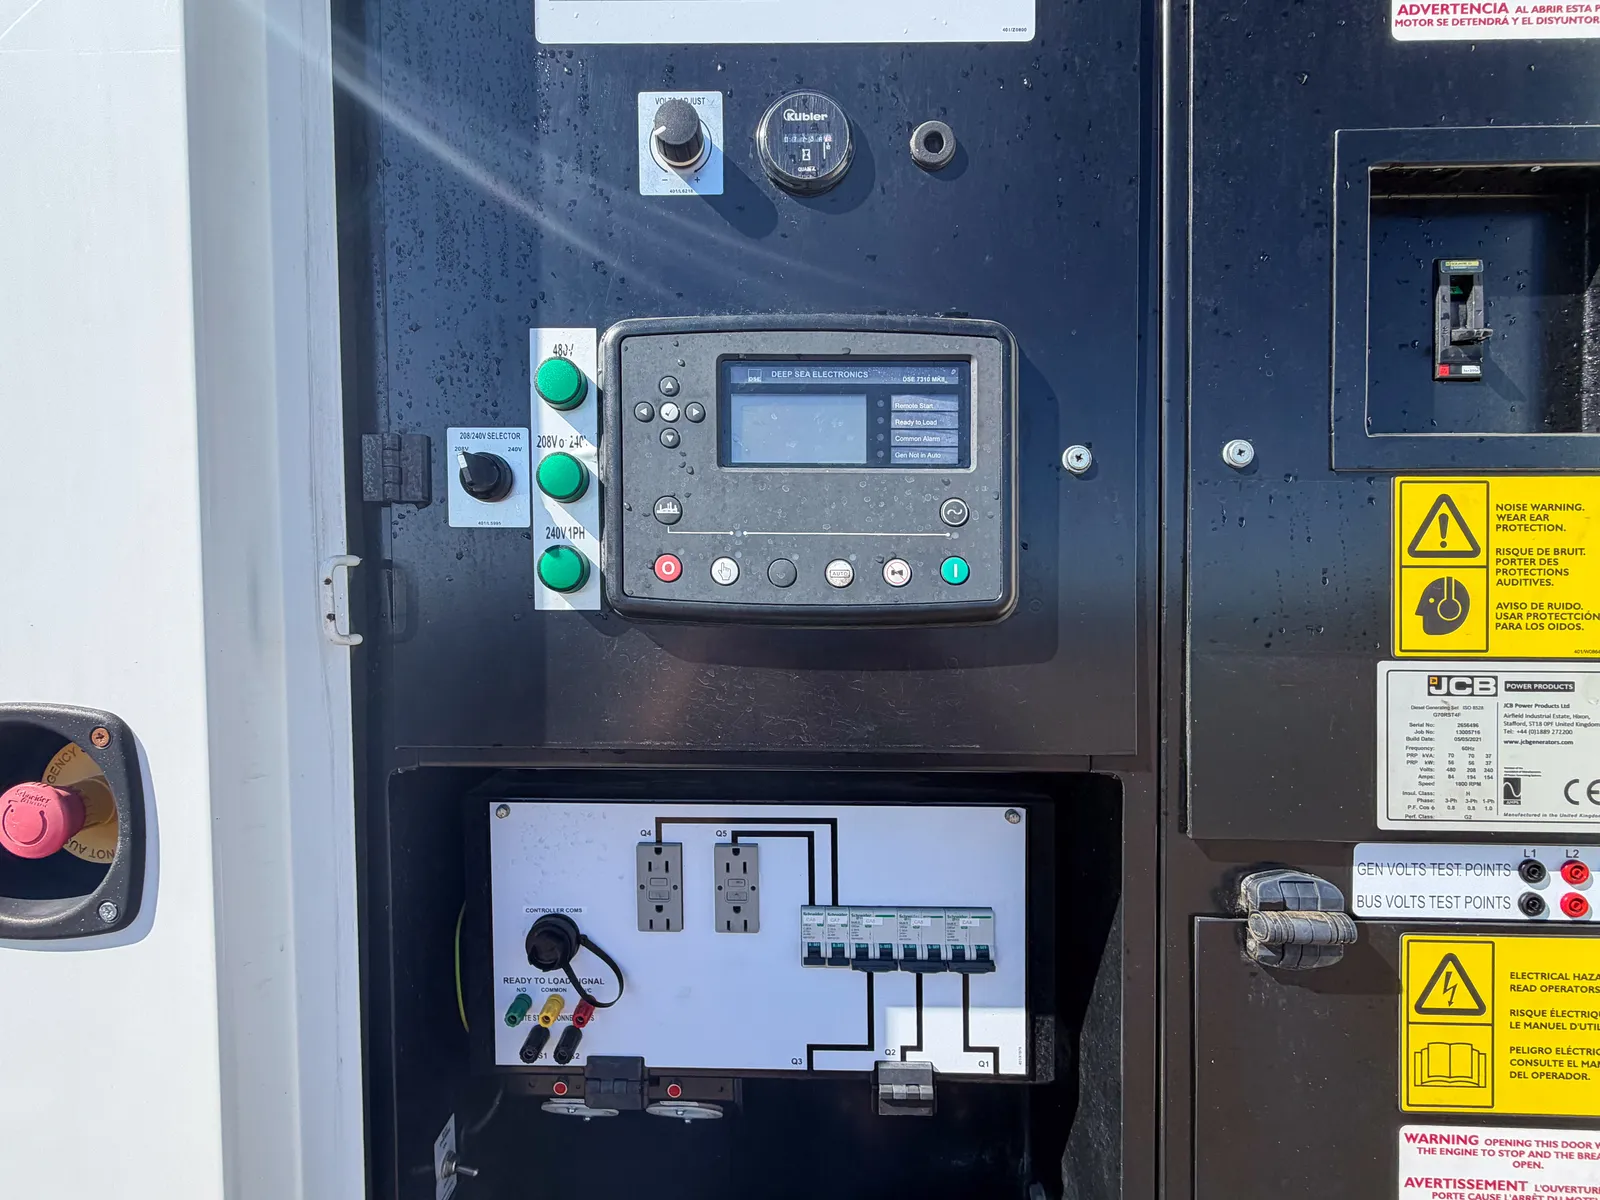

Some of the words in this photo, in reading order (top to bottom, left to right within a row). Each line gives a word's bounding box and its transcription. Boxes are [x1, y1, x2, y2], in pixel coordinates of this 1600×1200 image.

[1397, 2, 1509, 16] ADVERTENCIA
[1531, 5, 1563, 14] ABRIR
[1566, 5, 1592, 13] ESTA
[1395, 18, 1434, 27] MOTOR
[1436, 18, 1448, 26] SE
[1451, 15, 1509, 26] DETENDRÁ
[1511, 17, 1519, 25] Y
[1522, 17, 1534, 25] EL
[1536, 16, 1600, 25] DISYUNTOR
[771, 370, 793, 378] DEEP
[794, 370, 811, 378] SEA
[812, 370, 869, 378] ELECTRONICS
[895, 419, 915, 427] Ready
[460, 432, 486, 440] 208/240V
[487, 432, 521, 440] SELECTOR
[536, 435, 558, 448] 208V
[1496, 503, 1528, 511] NOISE
[1530, 503, 1585, 511] WARNING.
[1496, 513, 1527, 521] WEAR
[1530, 513, 1549, 521] EAR
[1496, 524, 1566, 532] PROTECTION.
[546, 526, 567, 540] 240V
[568, 526, 585, 540] 1PH
[1496, 548, 1534, 557] RISQUE
[1537, 548, 1551, 556] DE
[1553, 548, 1586, 556] BRUIT.
[1496, 558, 1536, 566] PORTER
[1539, 558, 1559, 566] DES
[1496, 568, 1569, 576] PROTECTIONS
[1496, 578, 1554, 586] AUDITIVES.
[1496, 602, 1528, 610] AVISO
[1530, 602, 1544, 610] DE
[1547, 602, 1583, 610] RUIDO.
[1495, 612, 1523, 620] USAR
[1495, 622, 1523, 630] PARA
[1525, 622, 1544, 631] LOS
[1548, 622, 1584, 631] OIDOS.
[1429, 677, 1496, 695] JCB
[1524, 849, 1536, 858] L1
[1566, 850, 1579, 858] L2
[1357, 862, 1384, 876] GEN
[1387, 862, 1426, 876] VOLTS
[1430, 863, 1461, 876] TEST
[1465, 863, 1511, 877] POINTS
[1356, 895, 1382, 909] BUS
[1385, 895, 1425, 909] VOLTS
[1430, 896, 1461, 909] TEST
[1464, 896, 1511, 909] POINTS
[503, 977, 532, 985] READY
[534, 977, 546, 985] TO
[548, 977, 571, 985] LOAD
[1510, 972, 1570, 981] ELECTRICAL
[1510, 984, 1537, 993] READ
[1540, 985, 1600, 994] OPERATORS
[1510, 1009, 1547, 1019] RISQUE
[1550, 1007, 1600, 1019] ÉLECTRIQ
[1510, 1021, 1521, 1030] LE
[1523, 1022, 1567, 1030] MANUEL
[884, 1049, 896, 1057] Q2
[1510, 1046, 1553, 1055] PELIGRO
[791, 1058, 803, 1066] Q3
[978, 1061, 989, 1069] Q1
[1510, 1059, 1564, 1068] CONSULTE
[1567, 1059, 1579, 1068] EL
[1510, 1071, 1529, 1079] DEL
[1531, 1072, 1591, 1081] OPERADOR.
[1404, 1133, 1479, 1146] WARNING
[1484, 1139, 1532, 1148] OPENING
[1534, 1140, 1559, 1148] THIS
[1561, 1141, 1593, 1149] DOOR
[1417, 1147, 1437, 1155] THE
[1439, 1148, 1479, 1156] ENGINE
[1481, 1148, 1495, 1157] TO
[1498, 1149, 1526, 1158] STOP
[1527, 1150, 1551, 1159] AND
[1554, 1151, 1575, 1159] THE
[1512, 1161, 1544, 1169] OPEN.
[1404, 1177, 1528, 1192] AVERTISSEMENT
[1431, 1192, 1465, 1200] PORTE
